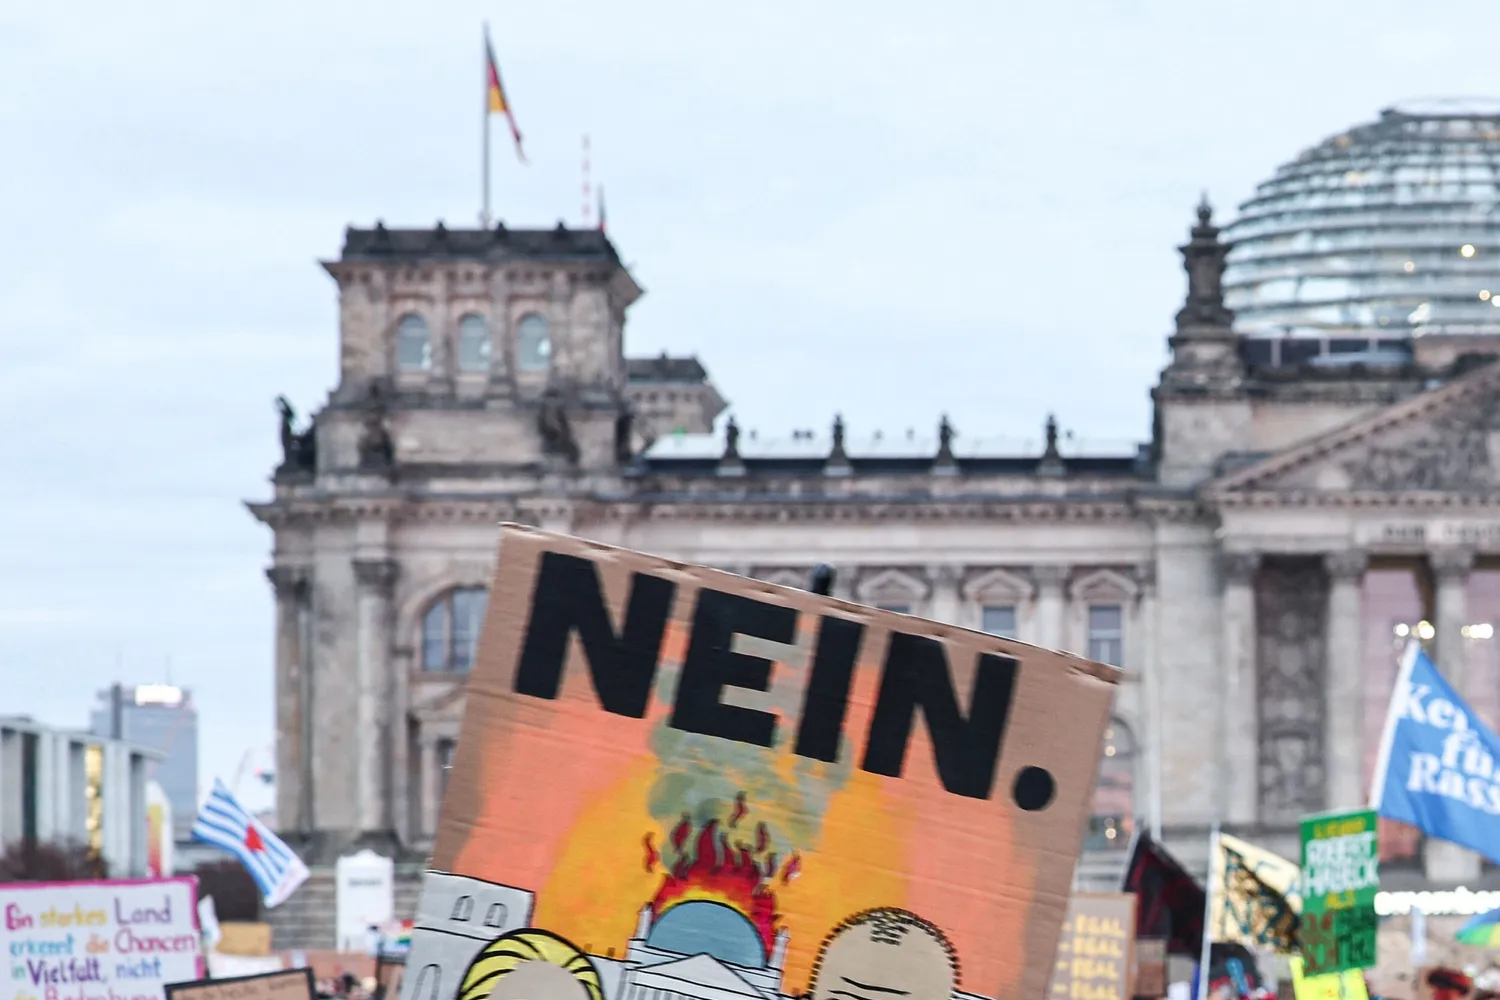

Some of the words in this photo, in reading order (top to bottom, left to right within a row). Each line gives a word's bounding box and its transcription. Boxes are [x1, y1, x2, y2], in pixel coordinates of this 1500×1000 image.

[513, 550, 1056, 811] NEIN.
[5, 902, 33, 931] Ein
[40, 902, 108, 928] starkes
[114, 895, 173, 925] Land
[114, 927, 196, 954] Chancen
[115, 957, 162, 979] nicht
